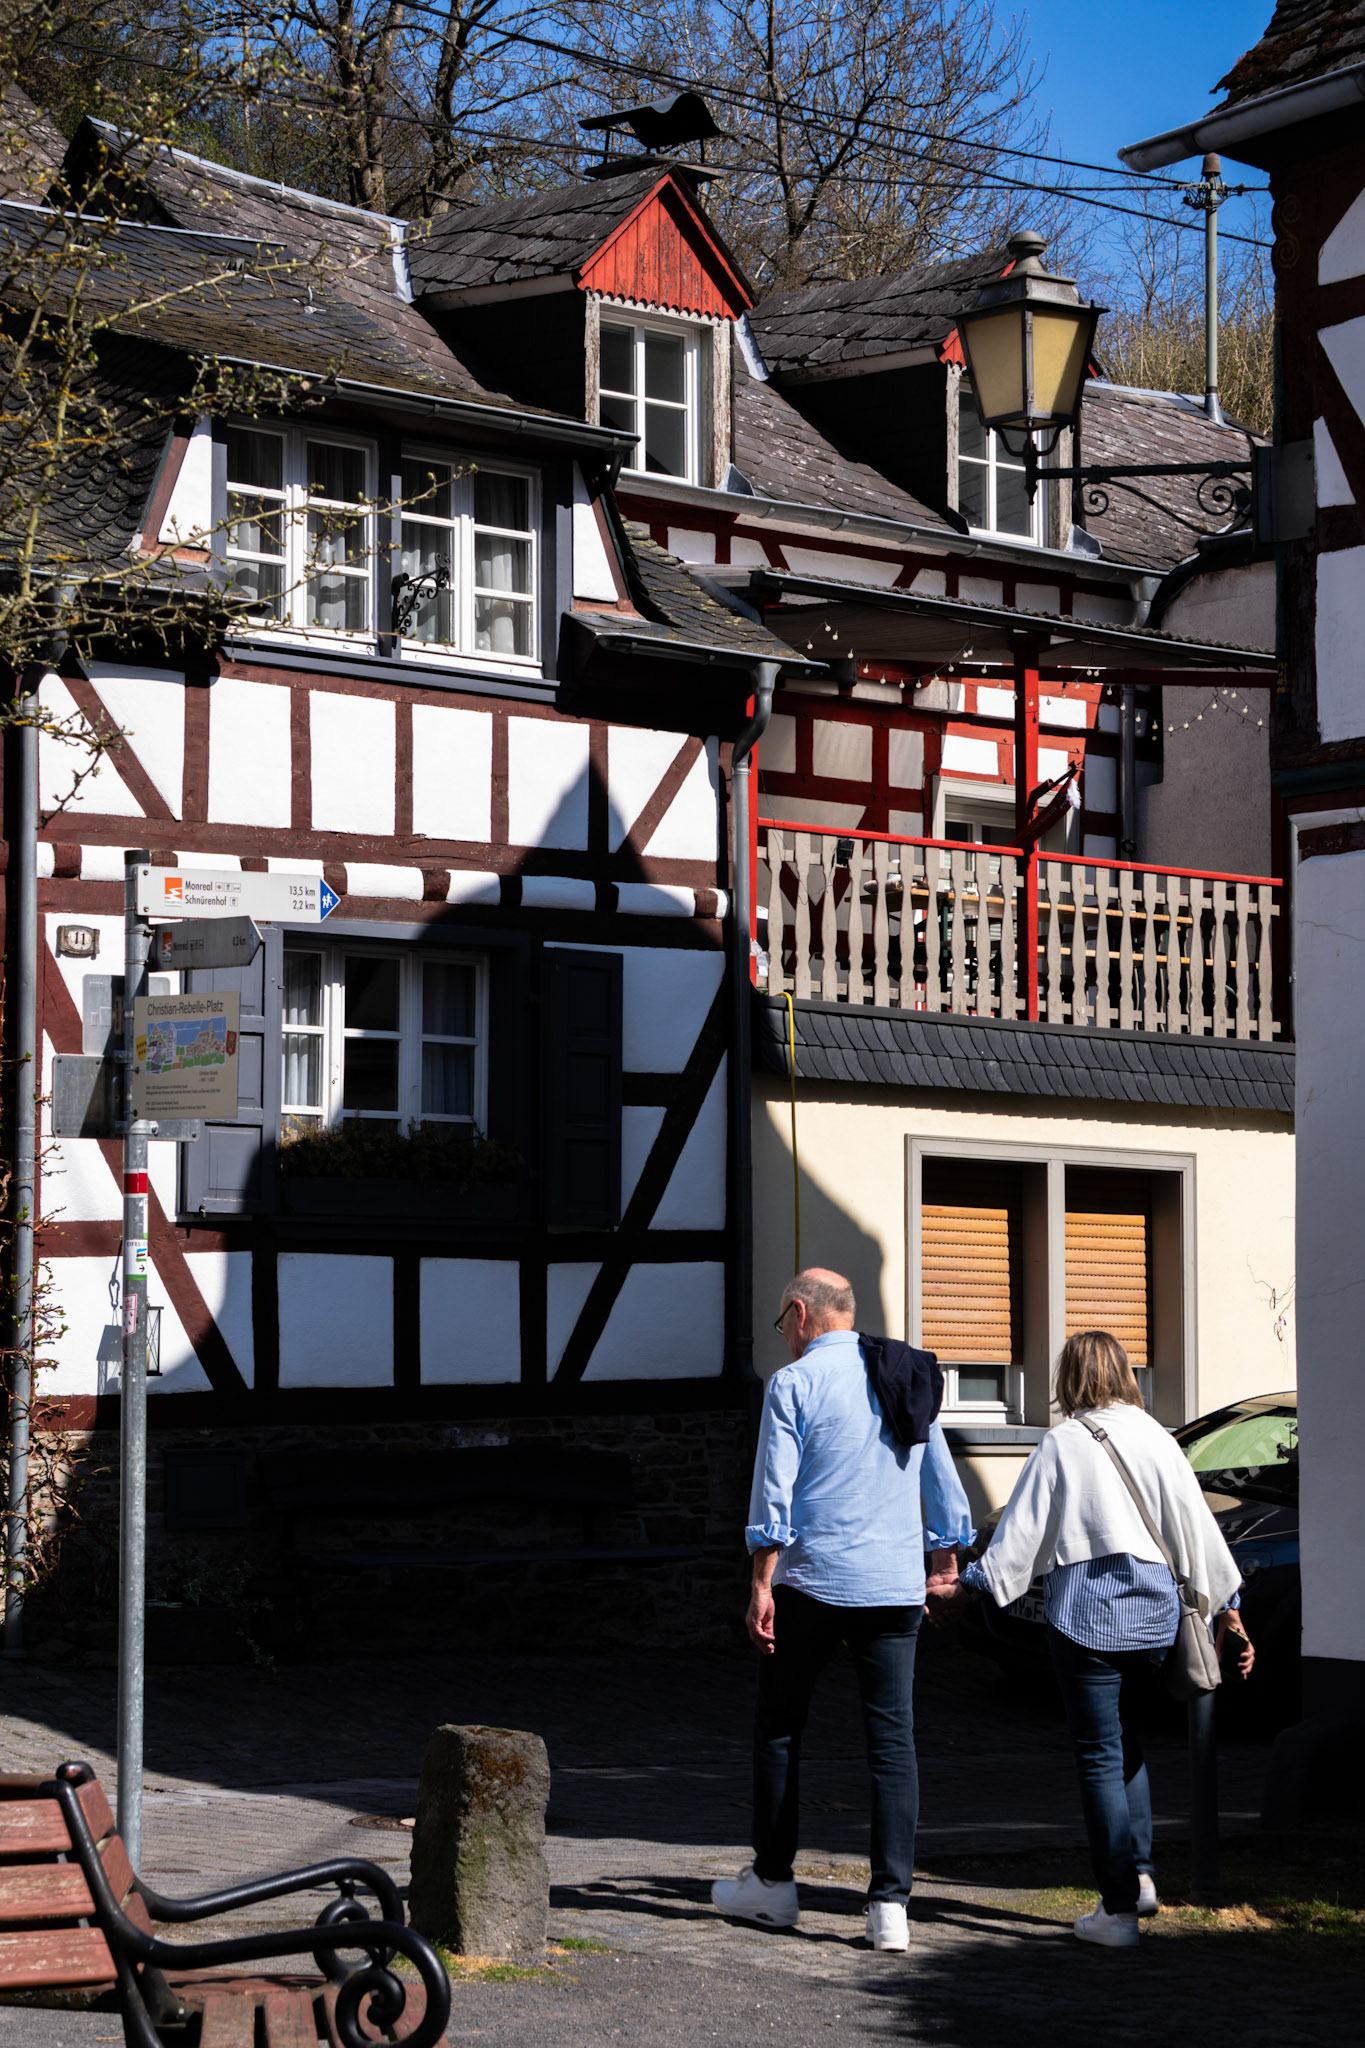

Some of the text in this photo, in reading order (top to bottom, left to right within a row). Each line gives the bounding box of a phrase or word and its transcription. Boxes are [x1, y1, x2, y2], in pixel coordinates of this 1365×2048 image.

[185, 880, 315, 897] Monreal 13,5 km
[185, 894, 227, 906] Schnürenhof
[293, 900, 303, 911] 2,2
[305, 900, 315, 910] km
[75, 931, 85, 945] 11
[147, 1000, 224, 1016] Christian-Rebelle-Platz
